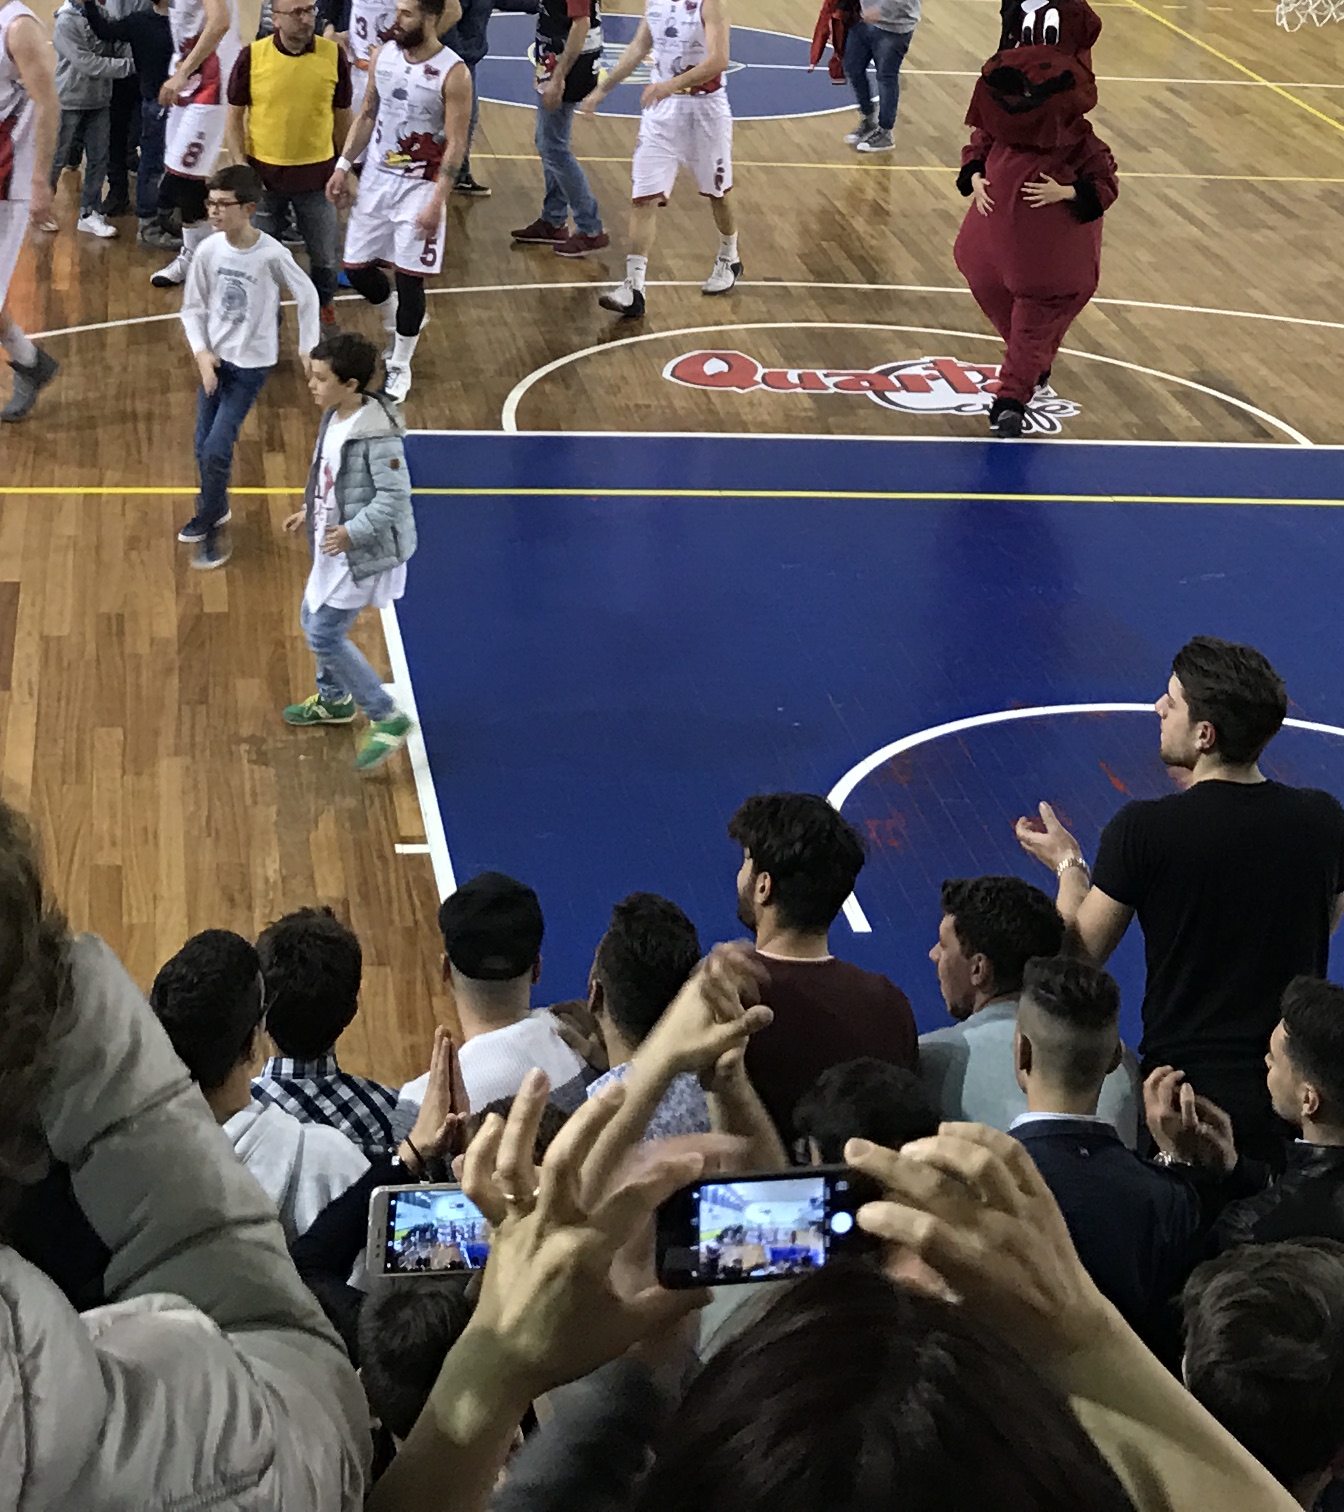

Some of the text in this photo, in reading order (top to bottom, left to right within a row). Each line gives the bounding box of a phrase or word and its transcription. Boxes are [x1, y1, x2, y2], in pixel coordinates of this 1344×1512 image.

[183, 142, 204, 168] 8
[420, 237, 438, 267] 5
[668, 350, 1003, 394] Quart
